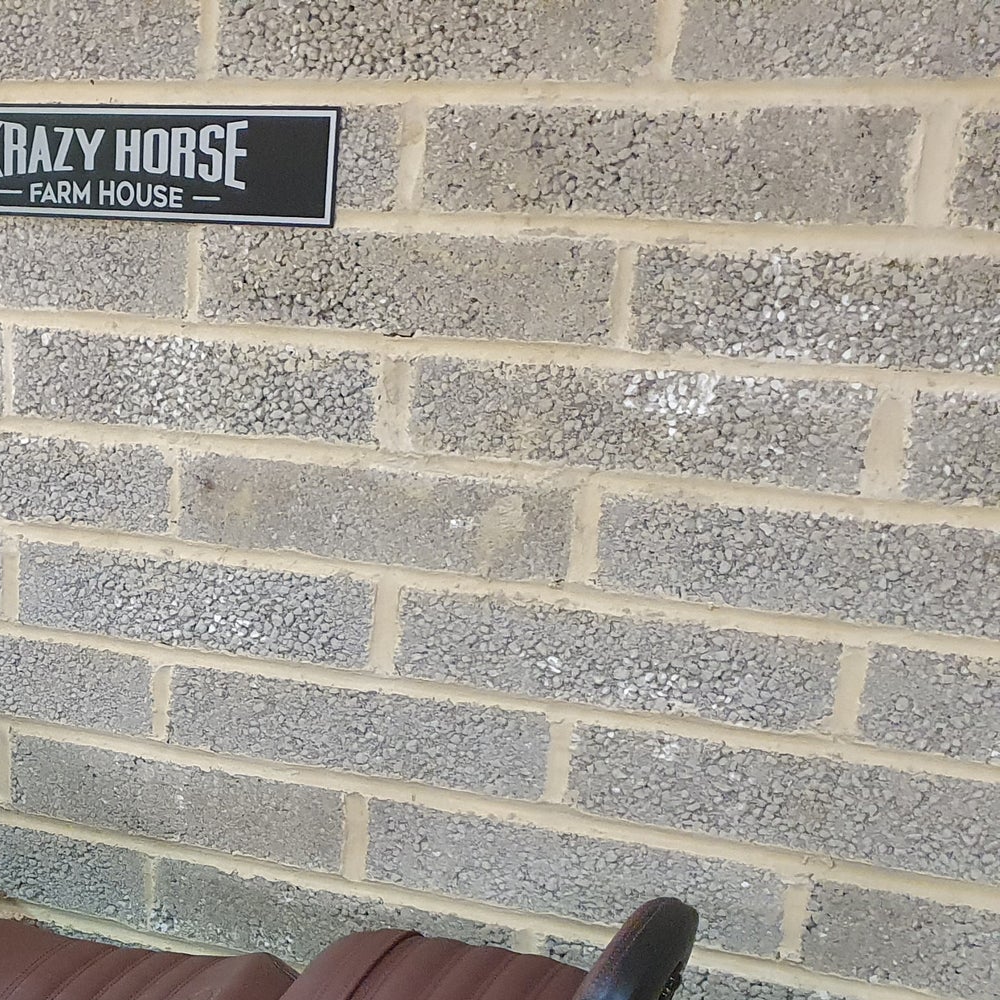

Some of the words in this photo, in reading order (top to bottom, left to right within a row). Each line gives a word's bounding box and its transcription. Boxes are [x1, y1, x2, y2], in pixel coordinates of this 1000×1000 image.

[115, 119, 248, 190] HORSE
[29, 182, 91, 204] FARM
[99, 180, 183, 208] HOUSE
